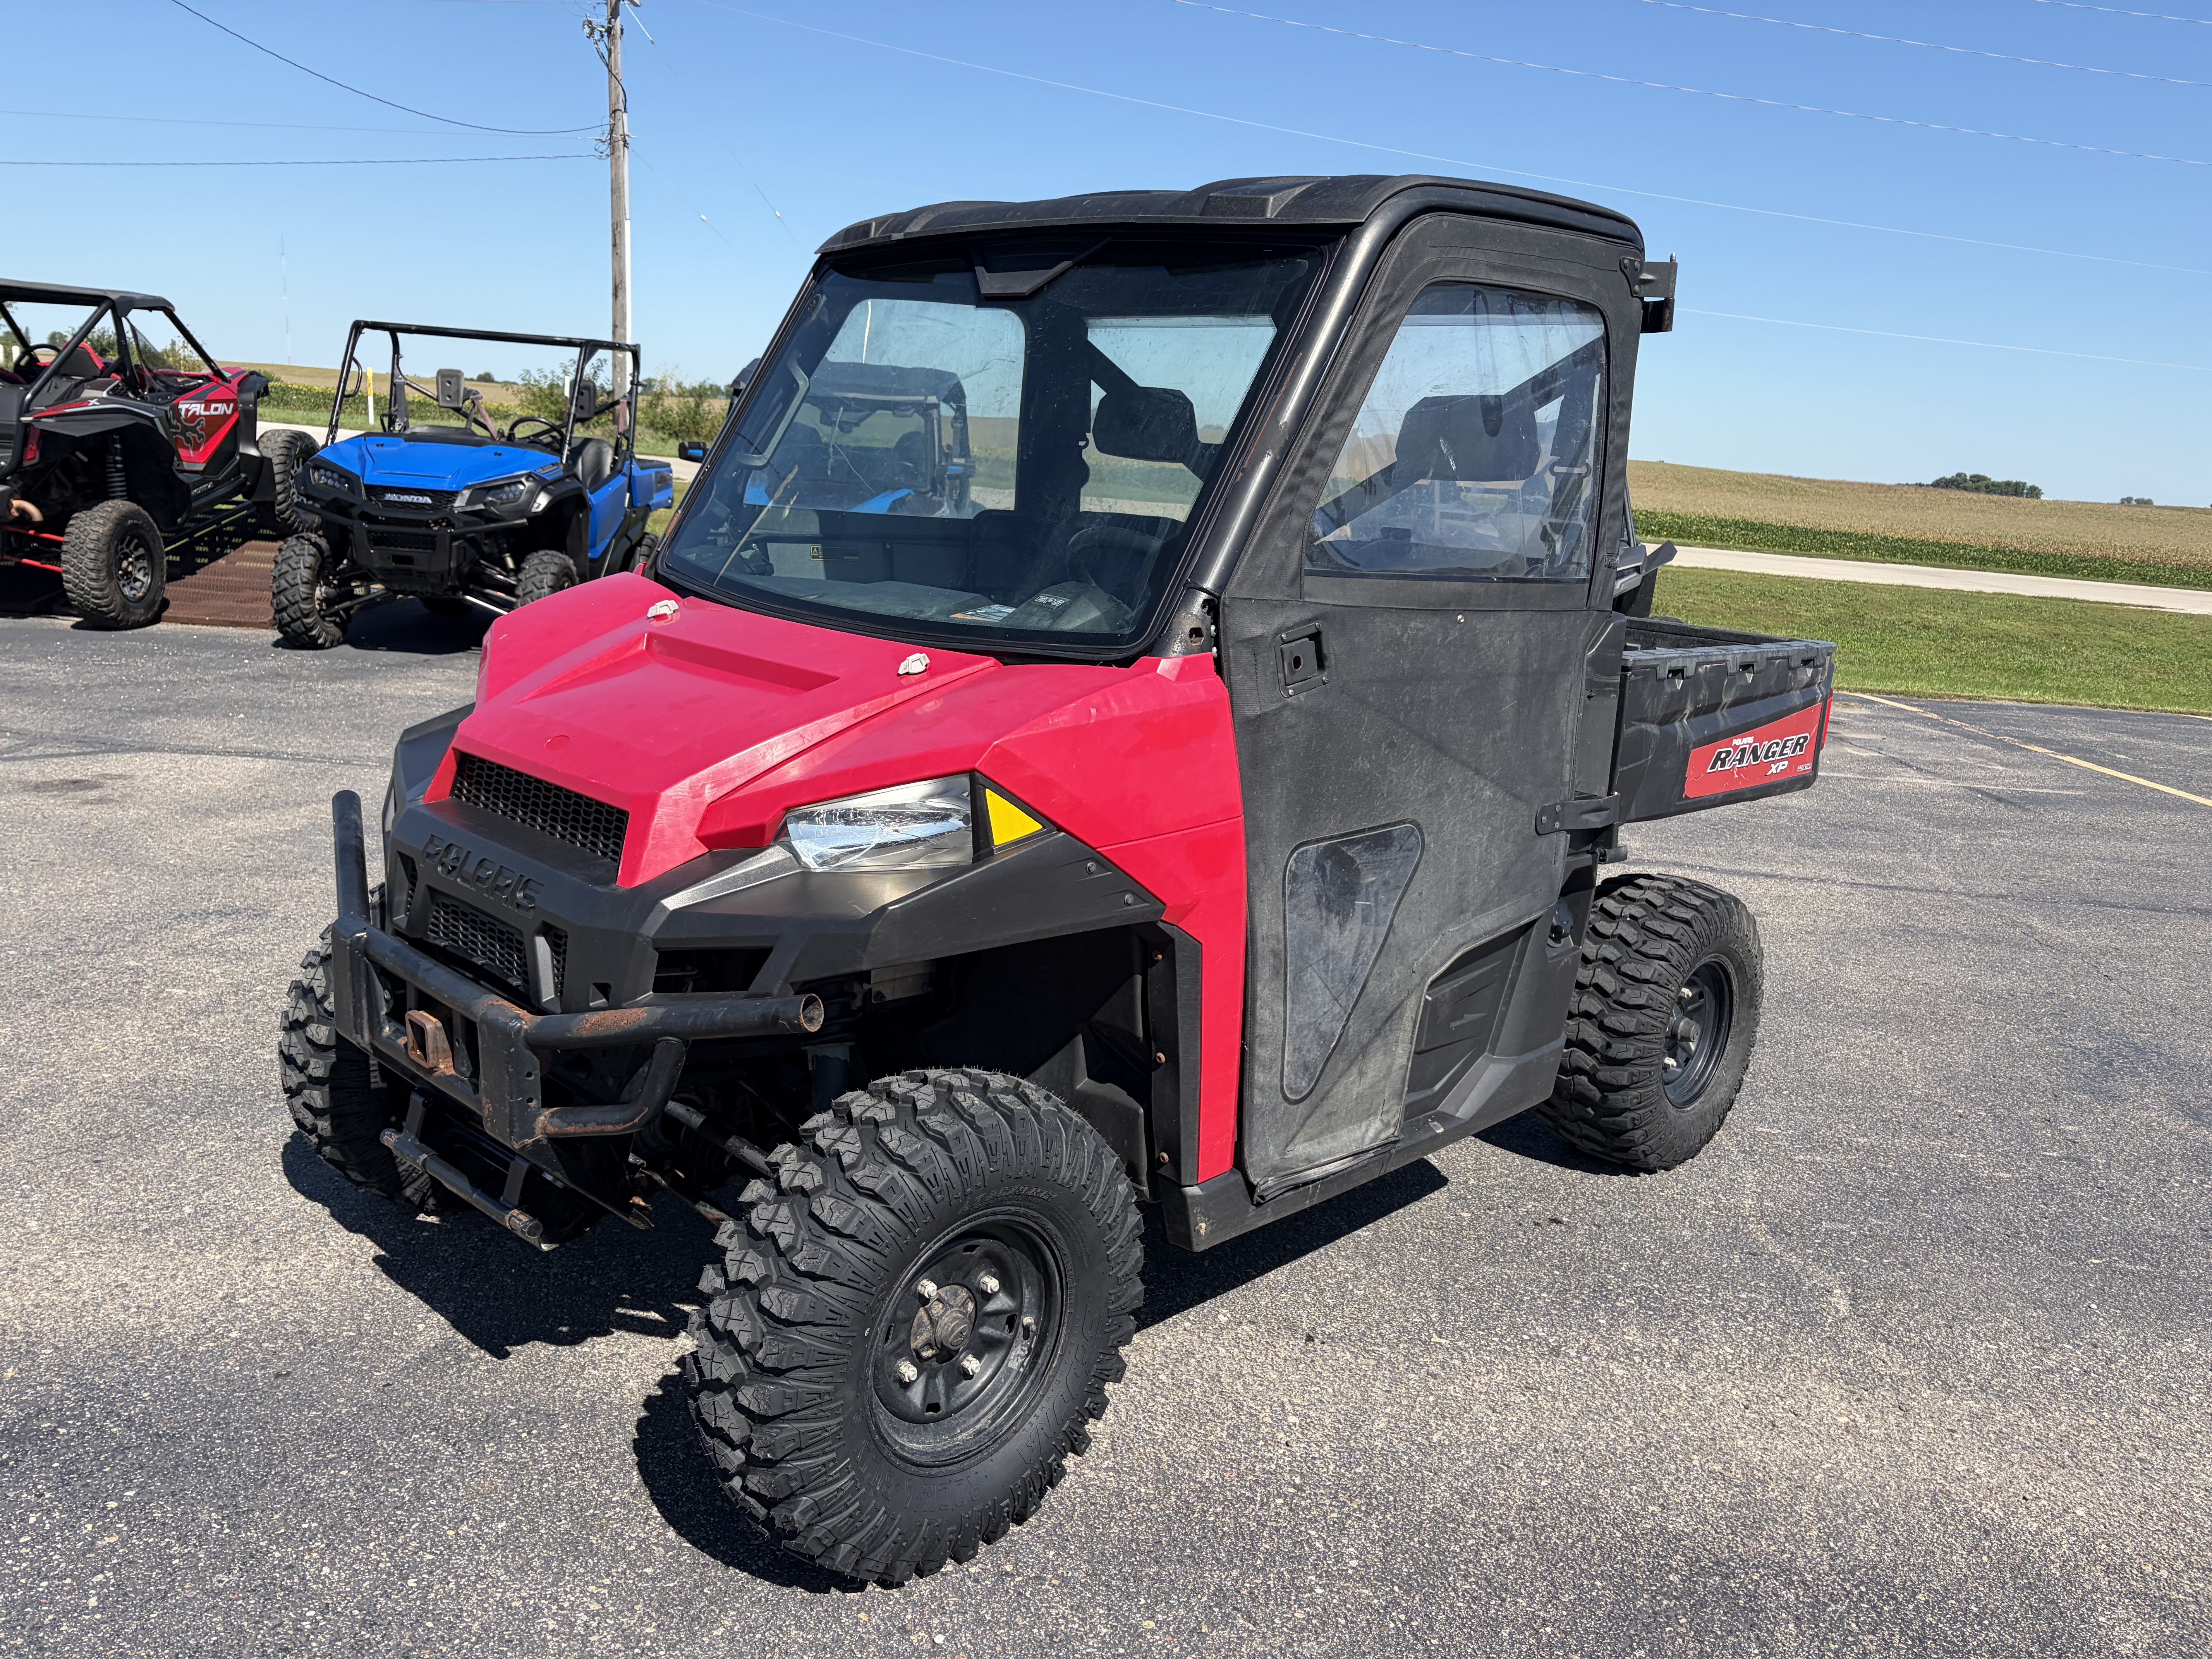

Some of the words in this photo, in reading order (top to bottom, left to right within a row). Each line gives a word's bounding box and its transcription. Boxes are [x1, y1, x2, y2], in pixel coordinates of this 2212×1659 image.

[178, 403, 234, 418] TALON
[384, 493, 432, 503] HONDA
[1035, 596, 1065, 606] EPS
[1732, 736, 1754, 746] POLARIS
[1707, 733, 1810, 773] RANGER
[1766, 760, 1788, 775] XP
[420, 834, 545, 919] POLARIS
